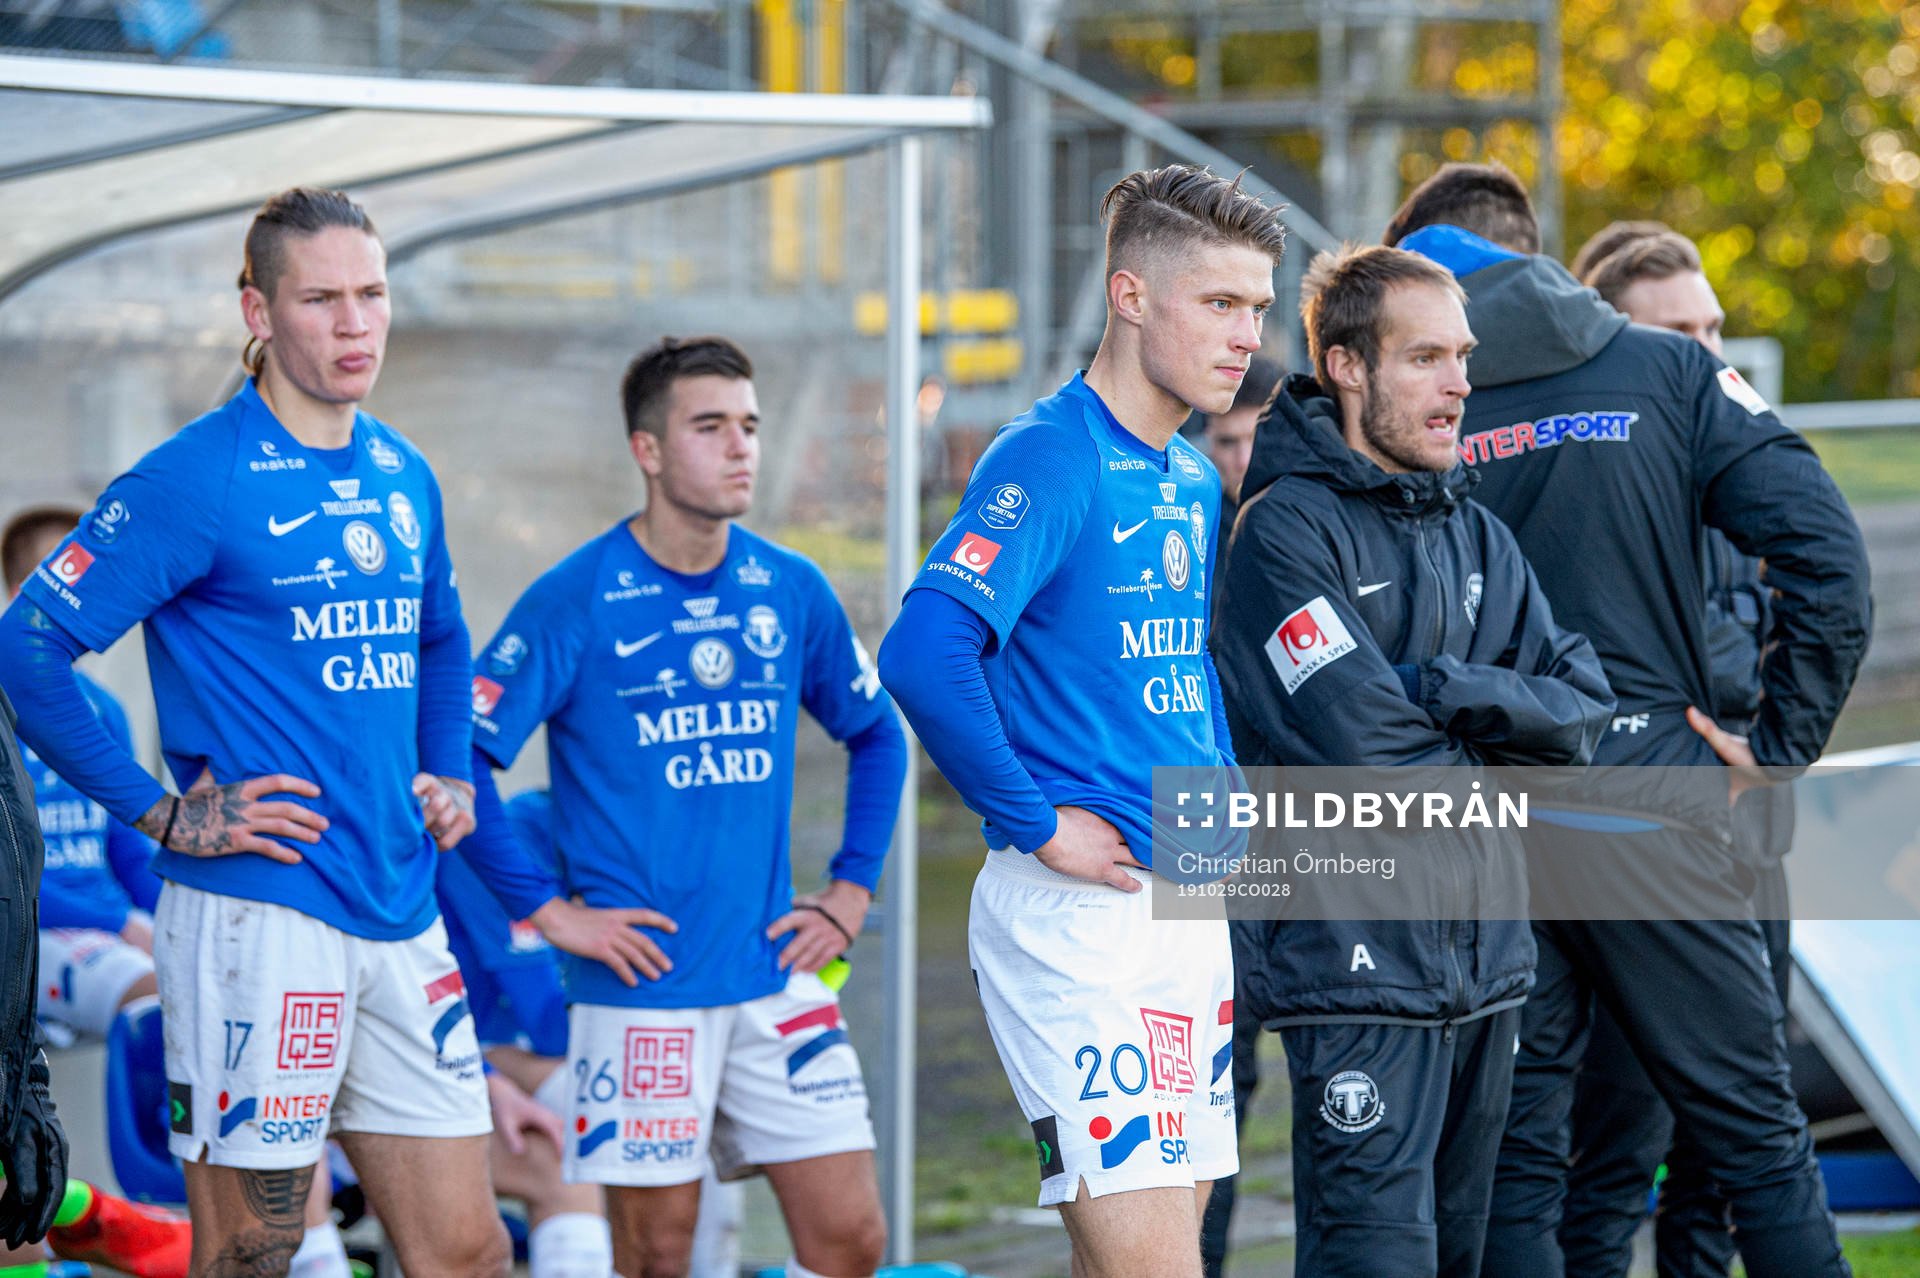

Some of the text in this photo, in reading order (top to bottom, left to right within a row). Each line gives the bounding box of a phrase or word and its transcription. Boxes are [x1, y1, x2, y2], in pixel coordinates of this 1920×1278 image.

[1456, 412, 1640, 466] NTERSPORT
[249, 457, 307, 472] exakta
[1108, 458, 1147, 471] exakta
[1152, 505, 1189, 522] TRELLEBORG
[927, 562, 996, 601] SVENSKA SPEL
[1119, 618, 1204, 659] MELLB
[321, 642, 416, 692] GÅRD
[1288, 642, 1353, 691] SVENSKA SPEL
[1143, 663, 1205, 715] GÅR
[665, 741, 773, 790] GÅRD
[1350, 943, 1377, 972] A
[224, 1020, 254, 1070] 17
[574, 1058, 617, 1104] 26
[1075, 1043, 1148, 1101] 20
[263, 1094, 330, 1119] INTER
[261, 1118, 324, 1143] SPORT
[623, 1117, 698, 1140] INTER
[622, 1139, 695, 1163] SPORT
